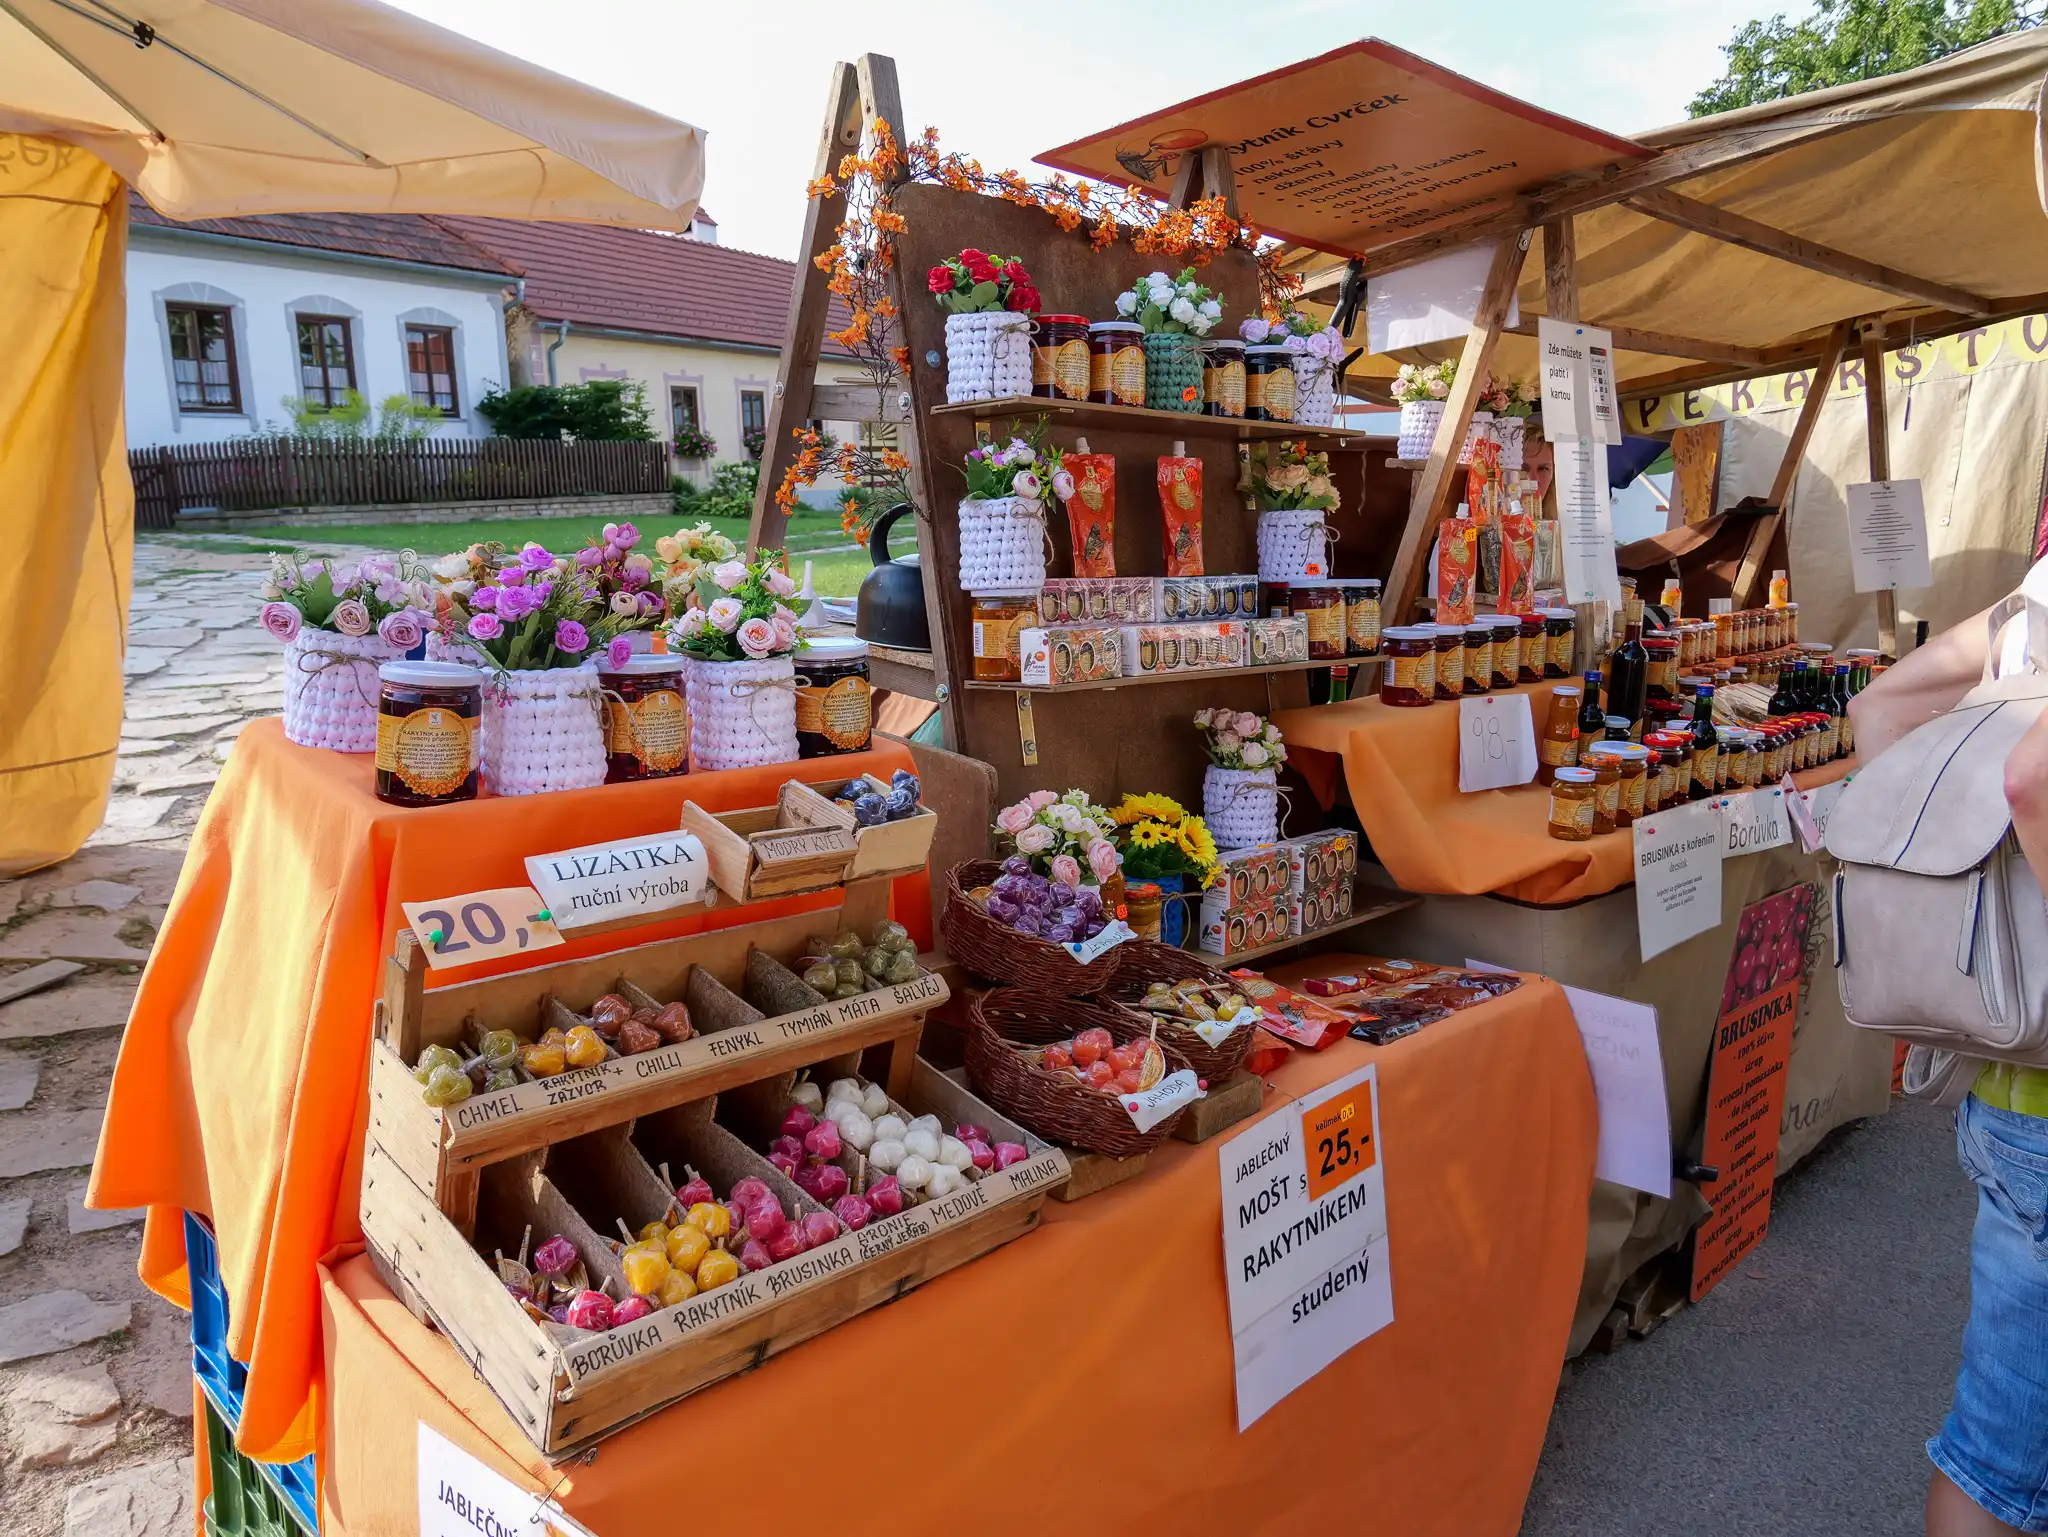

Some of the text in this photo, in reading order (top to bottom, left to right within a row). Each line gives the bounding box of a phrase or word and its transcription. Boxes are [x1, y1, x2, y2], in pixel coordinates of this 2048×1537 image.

[1306, 93, 1409, 129] Cvrček
[1253, 159, 1324, 185] nektary
[1273, 170, 1336, 191] džemy
[1293, 162, 1399, 198] marmelády
[1332, 176, 1430, 210] do jogurtu
[1548, 343, 1582, 359] Zde můžete
[1549, 366, 1566, 379] platit
[1550, 387, 1571, 401] kartou
[1472, 716, 1516, 767] 98,-
[1641, 832, 1715, 867] BRUSINKA s kořením
[1728, 814, 1779, 850] Borůvka
[550, 841, 694, 883] LÍZÁTKA
[571, 876, 690, 910] ruční výroba
[417, 900, 541, 955] 20,-
[636, 976, 942, 1078] CHILLI FENYKL TYMIÁN MÁTA ŠALVĚJ
[1719, 991, 1792, 1051] BRUSINKA
[457, 1094, 524, 1128] CHMEL
[1236, 1132, 1291, 1183] JABLEČNÝ
[1319, 1127, 1370, 1178] 25,-
[1009, 1159, 1060, 1190] MALINA
[1239, 1174, 1290, 1229] MOŠT
[1243, 1183, 1367, 1283] RAKYTNÍKEM
[571, 1182, 989, 1380] BORŮVKA RAKYTNÍK BRUSINKA ARONIE MEDOVÉ
[1291, 1250, 1370, 1325] studený
